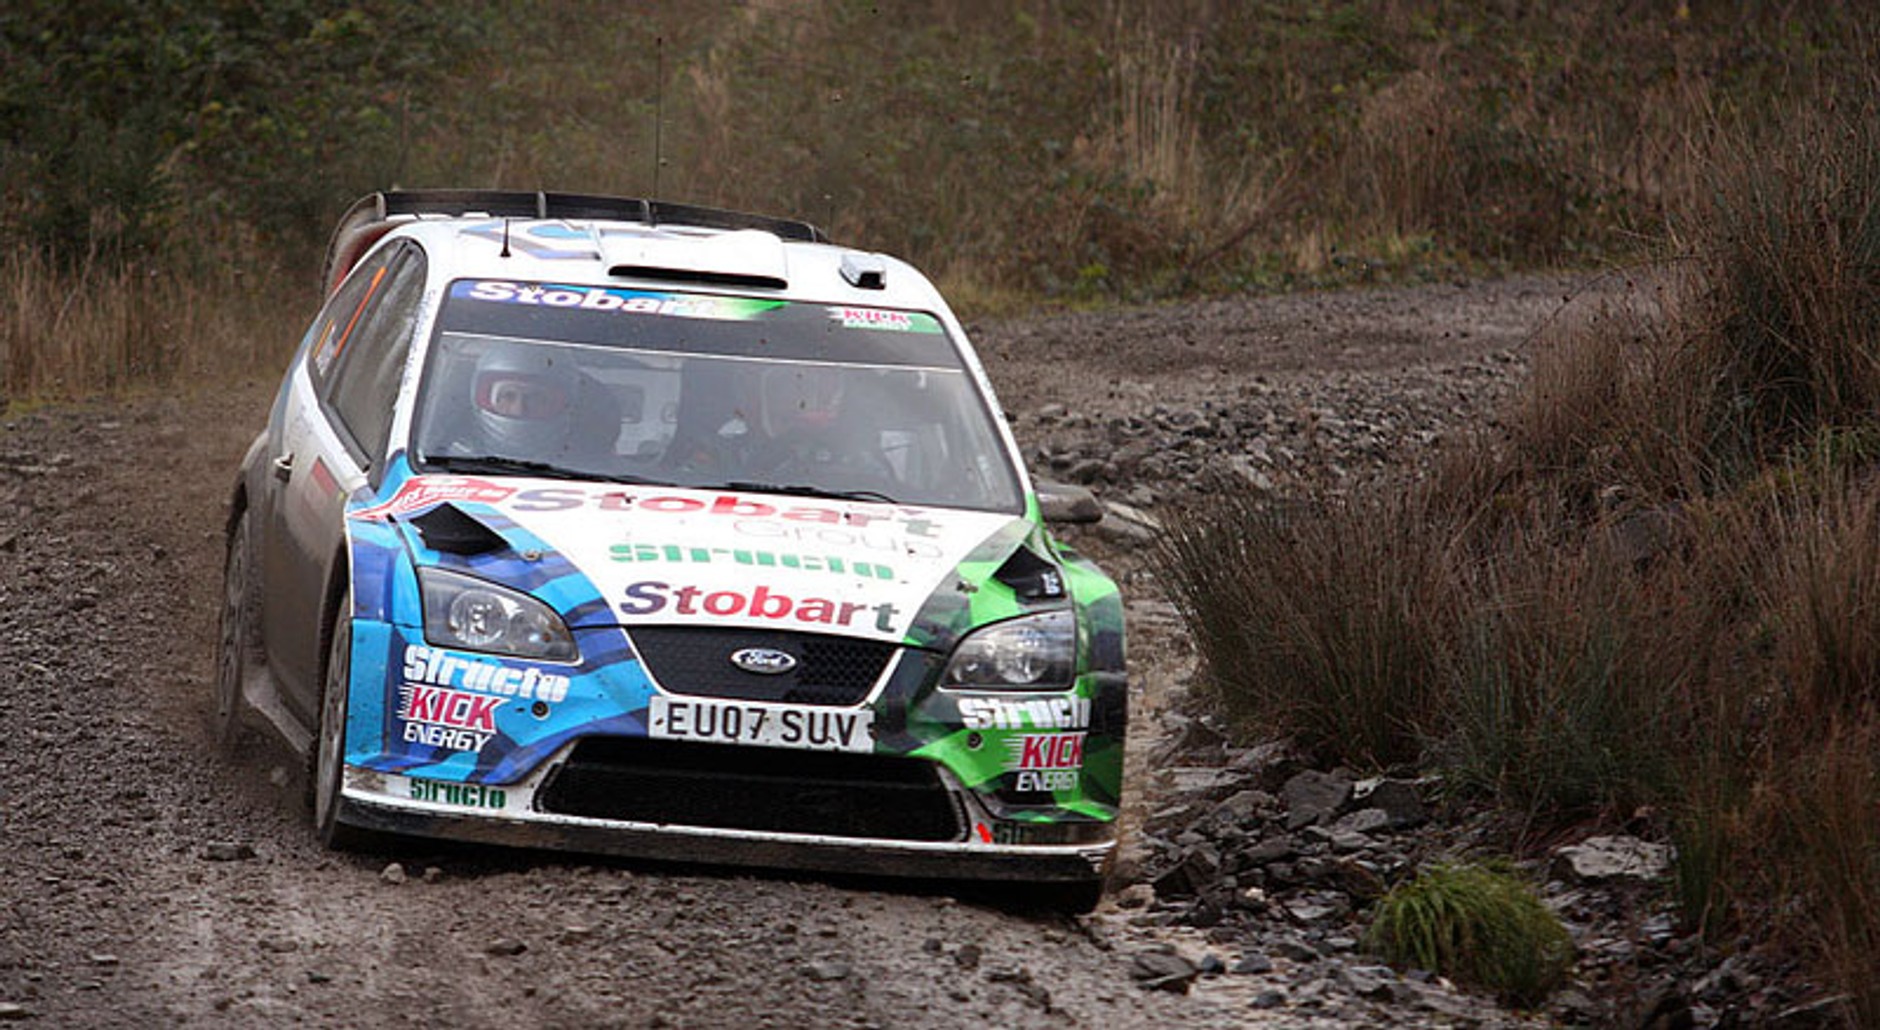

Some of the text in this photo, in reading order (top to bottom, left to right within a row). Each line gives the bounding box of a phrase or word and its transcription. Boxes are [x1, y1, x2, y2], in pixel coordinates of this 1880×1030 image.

[512, 488, 944, 539] Stobart
[619, 580, 901, 633] Stobart
[403, 643, 571, 704] Structo
[407, 686, 502, 731] KICK
[666, 702, 857, 747] EU07 SUV
[403, 720, 493, 753] ENERGY
